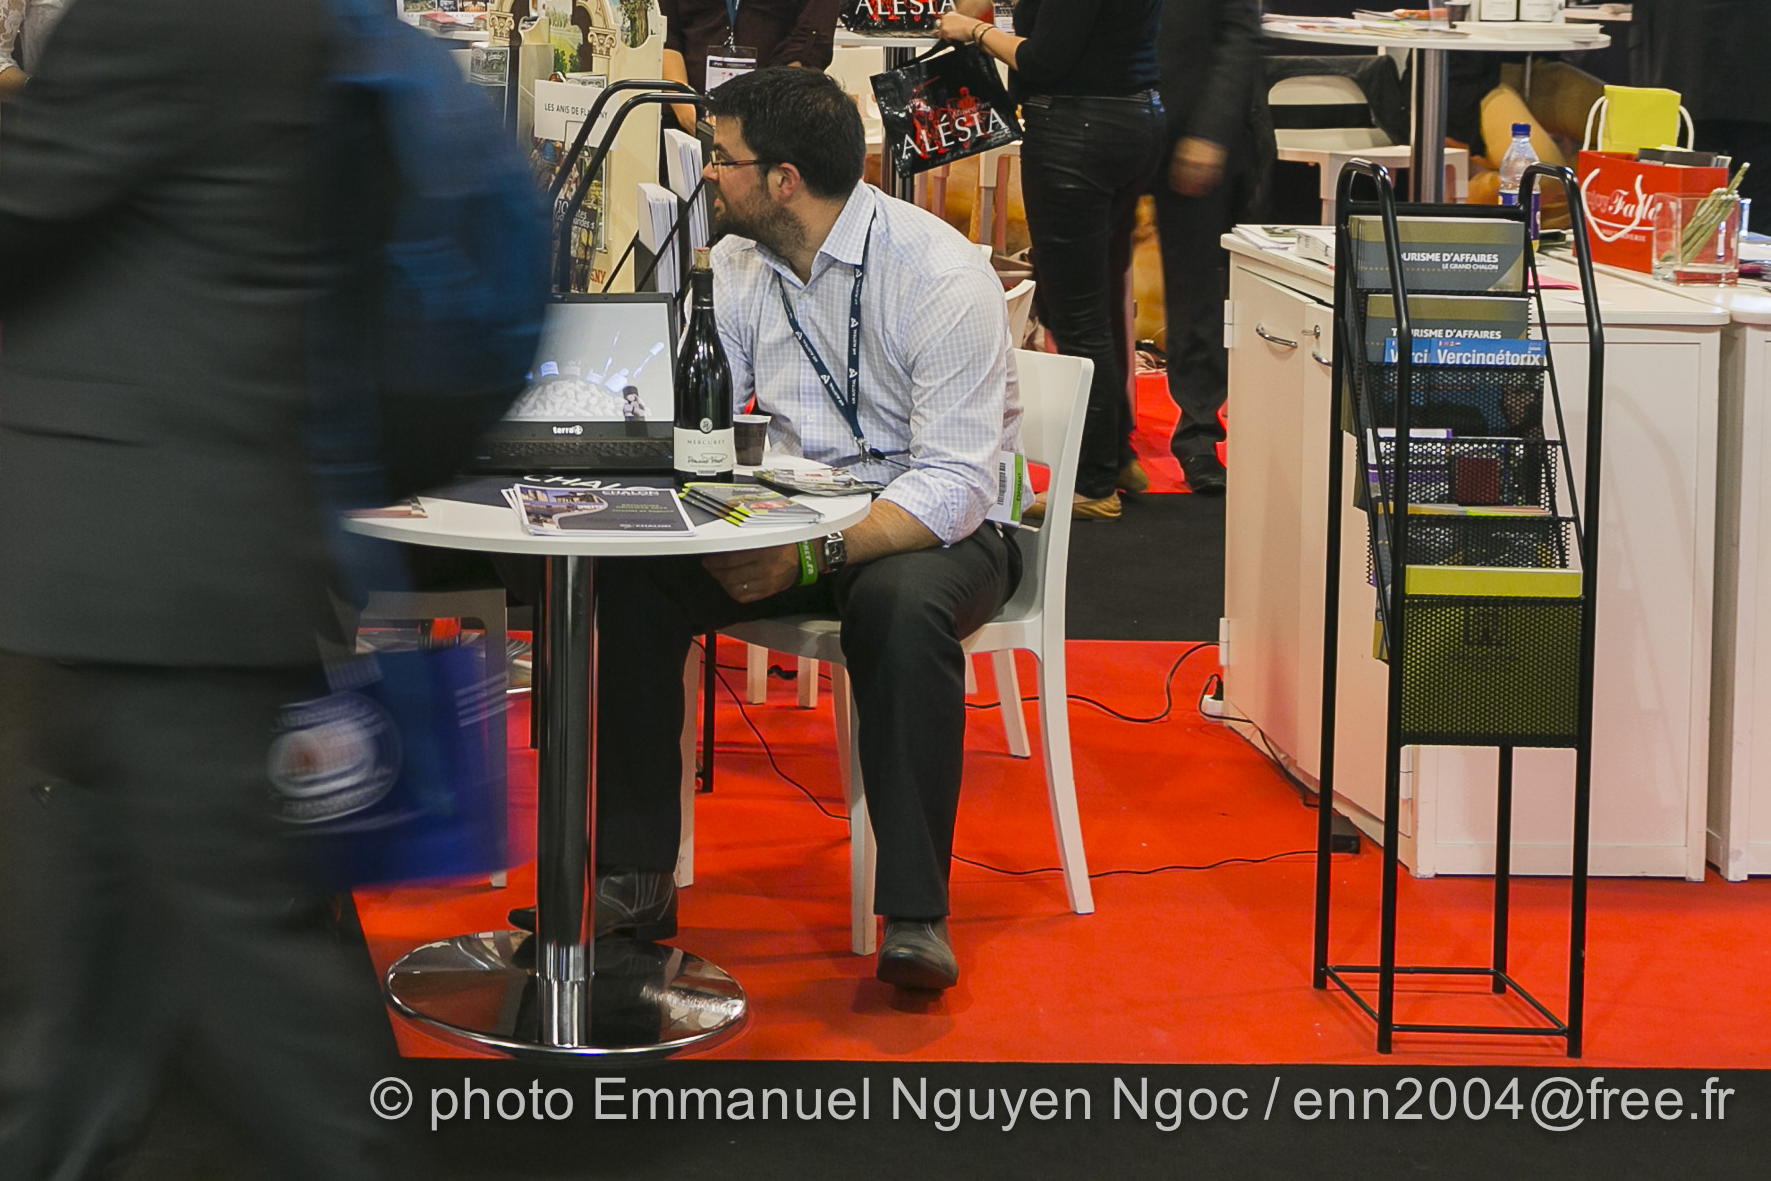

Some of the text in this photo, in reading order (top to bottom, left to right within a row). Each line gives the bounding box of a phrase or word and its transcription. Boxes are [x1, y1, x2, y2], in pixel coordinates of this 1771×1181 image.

[545, 103, 579, 115] LES ANIS DE
[902, 108, 1009, 159] ALÉSIA
[1442, 253, 1499, 263] D'AFFAIRES
[1445, 329, 1502, 339] D'AFFAIRES
[1437, 348, 1542, 365] Vercingétorix
[552, 426, 575, 434] terra
